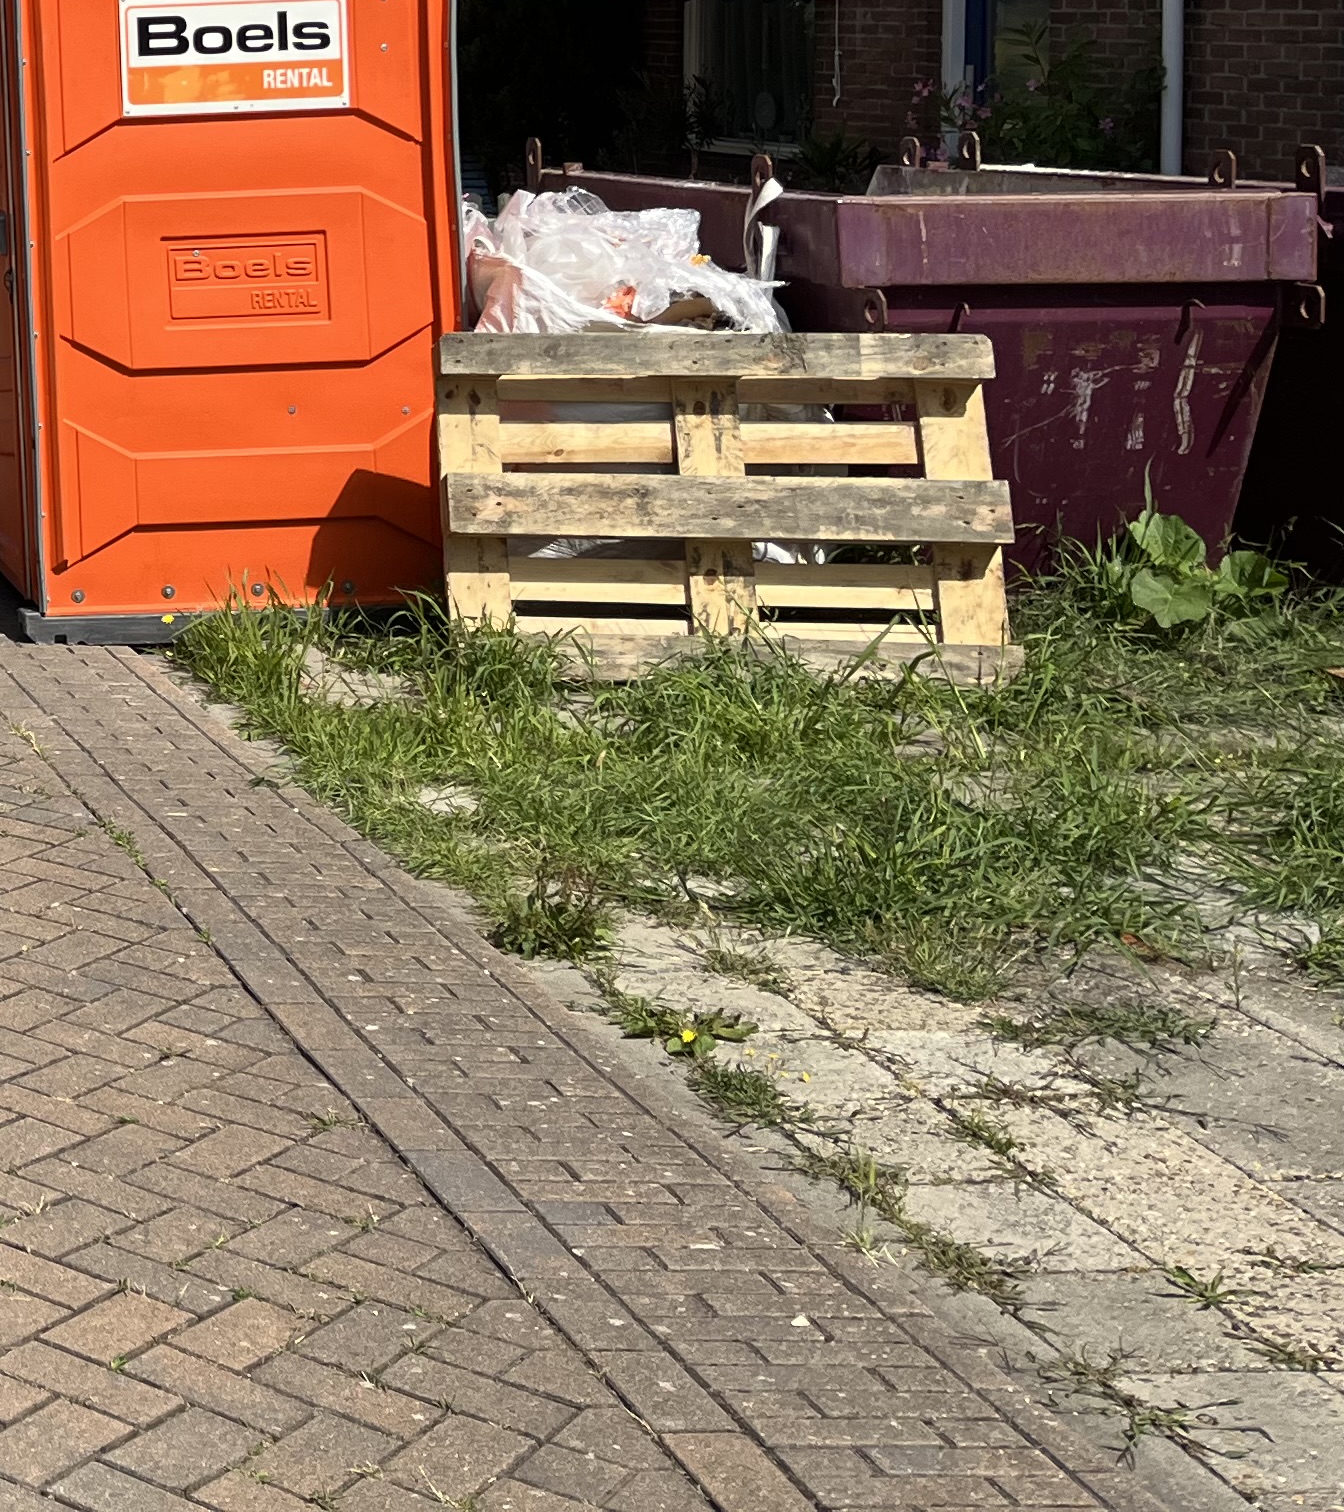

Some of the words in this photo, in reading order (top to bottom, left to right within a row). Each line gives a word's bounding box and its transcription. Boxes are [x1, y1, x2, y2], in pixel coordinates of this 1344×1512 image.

[136, 10, 331, 56] Boels
[263, 67, 333, 89] RENTAL
[174, 252, 313, 281] Boels
[250, 288, 318, 310] RENTAL
